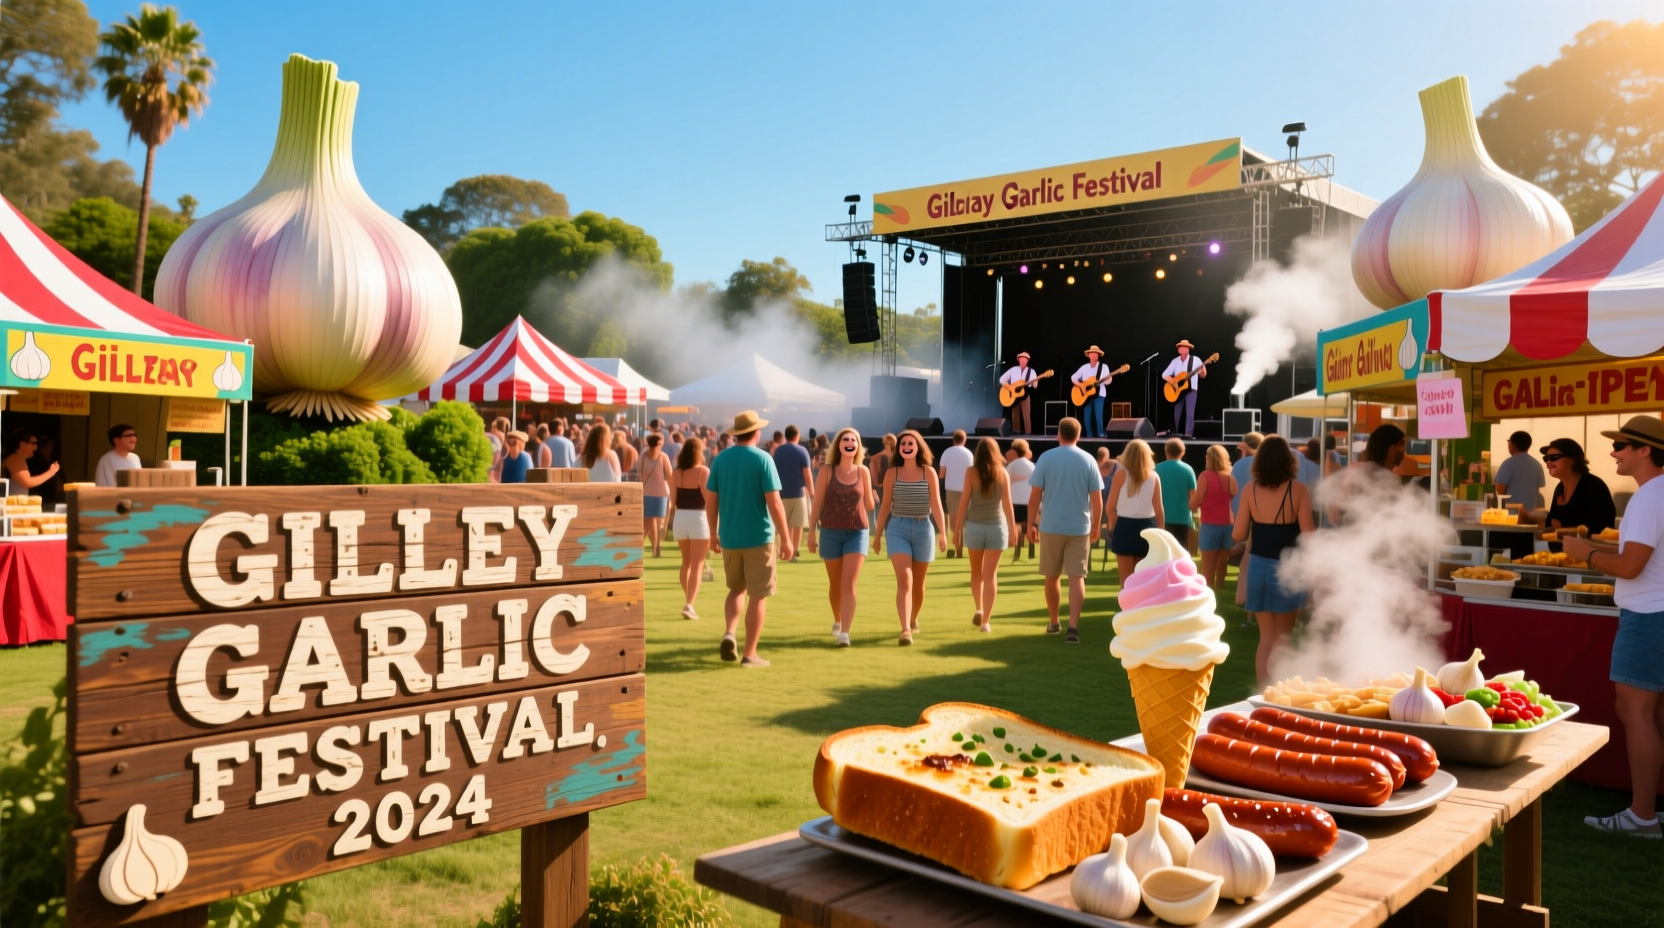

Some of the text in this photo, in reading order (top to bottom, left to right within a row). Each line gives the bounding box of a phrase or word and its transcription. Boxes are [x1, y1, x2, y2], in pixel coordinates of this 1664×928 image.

[1001, 178, 1065, 211] Garlic
[1072, 161, 1162, 200] Festival
[188, 504, 579, 608] GILLEY
[176, 593, 591, 725] GARLIC
[333, 774, 493, 856] 2024
